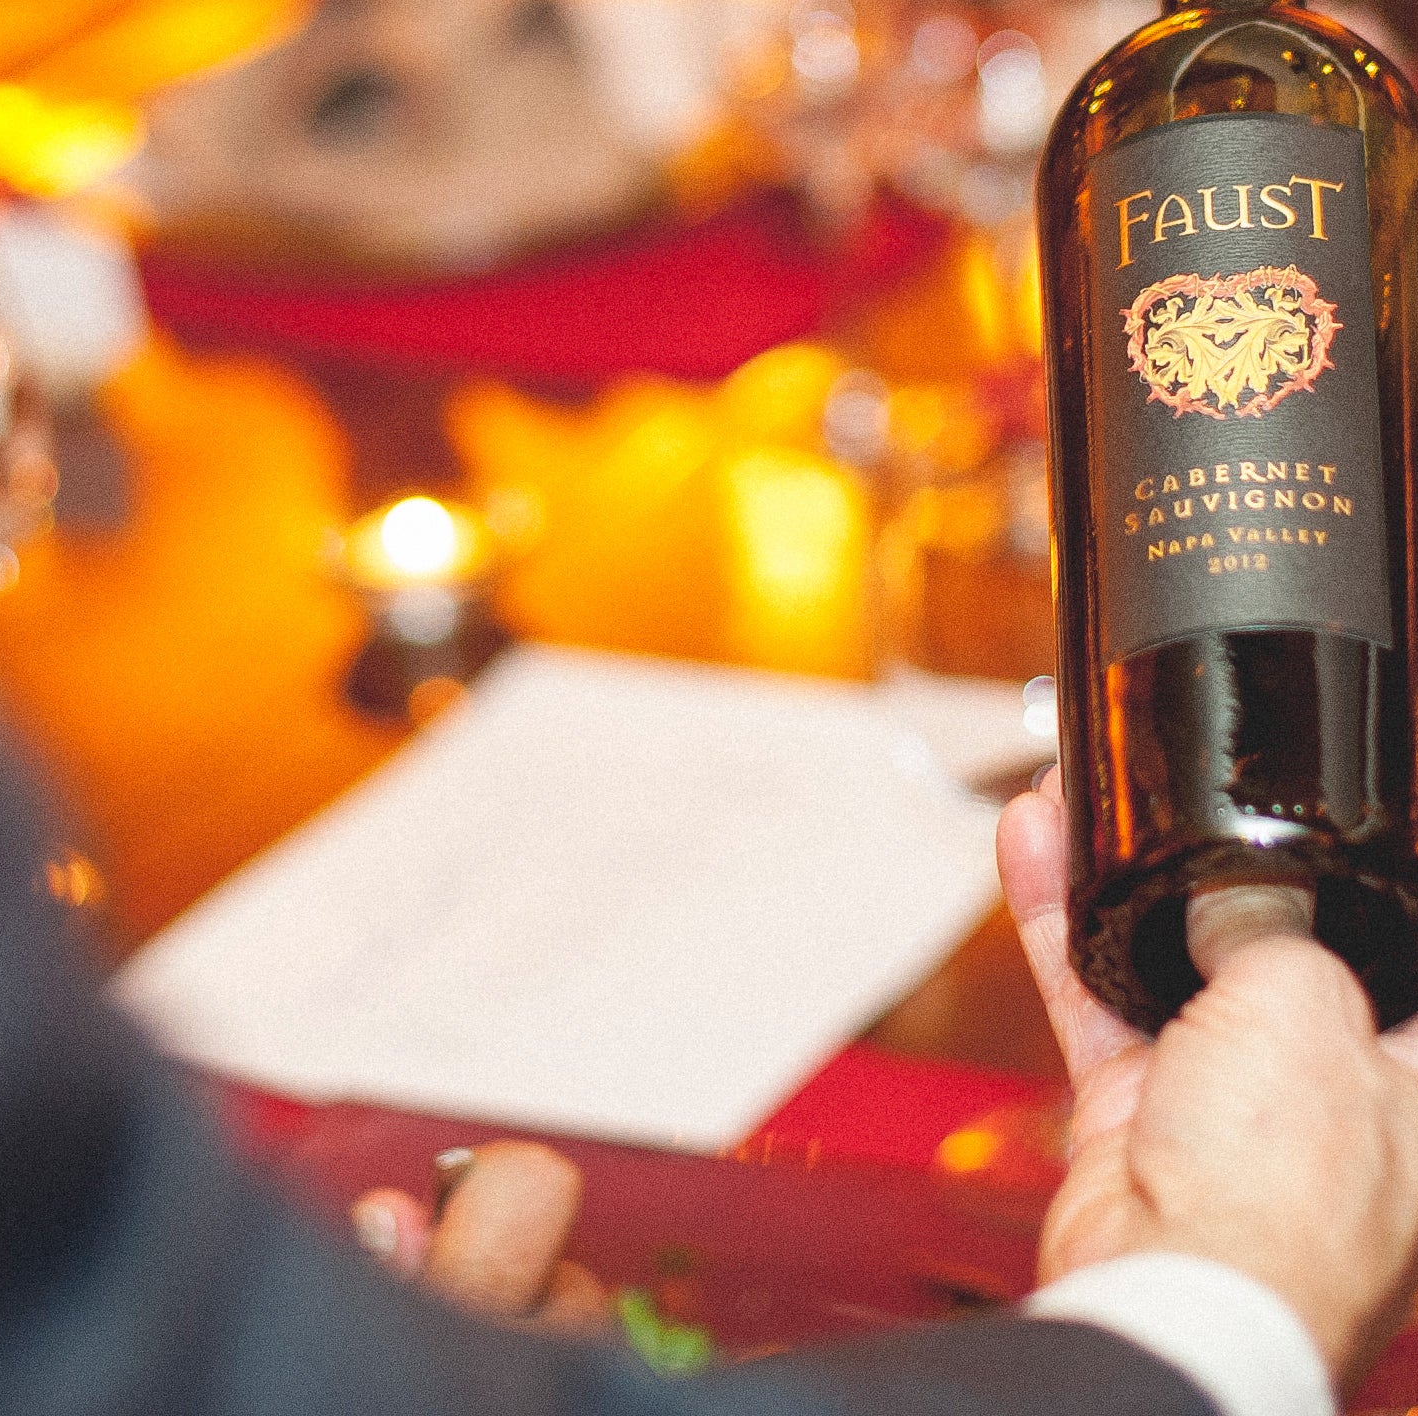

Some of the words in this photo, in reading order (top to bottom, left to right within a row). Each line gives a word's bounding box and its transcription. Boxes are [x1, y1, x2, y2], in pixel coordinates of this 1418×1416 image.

[1113, 174, 1343, 271] FAUST
[1134, 461, 1337, 502] CABERNET
[1124, 489, 1355, 535] SAUVIGNON
[1207, 553, 1270, 575] 2012
